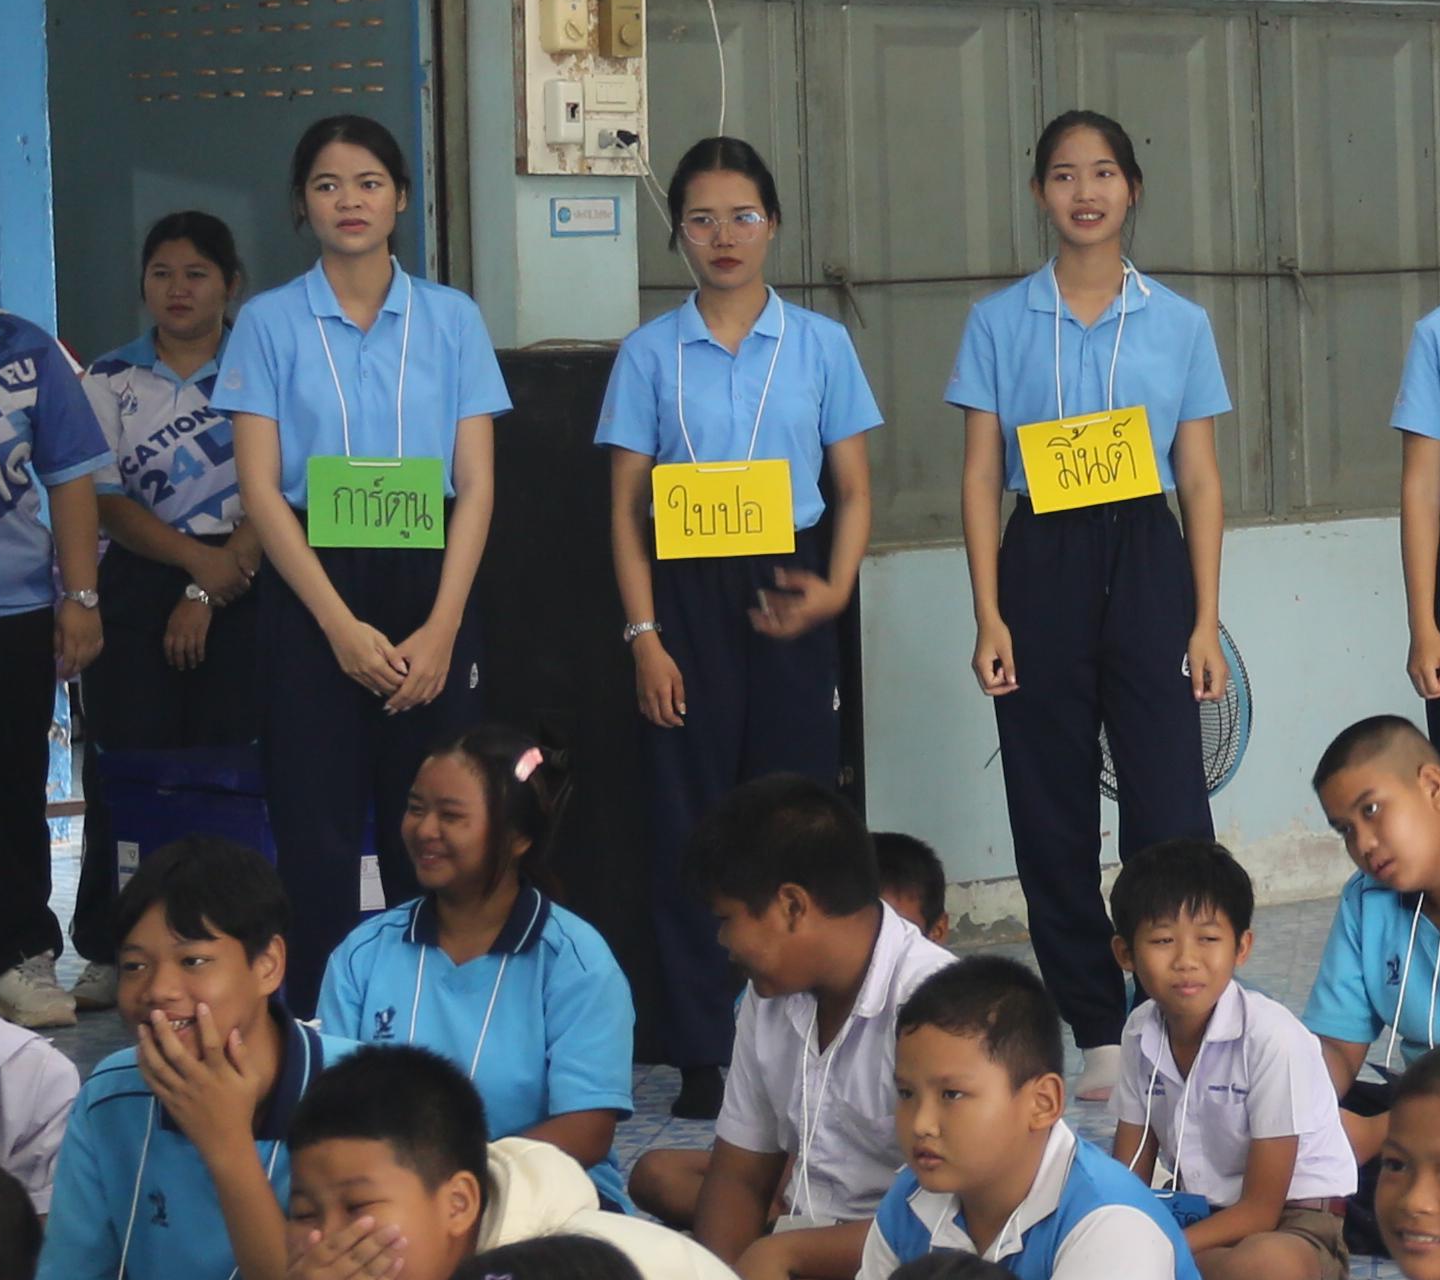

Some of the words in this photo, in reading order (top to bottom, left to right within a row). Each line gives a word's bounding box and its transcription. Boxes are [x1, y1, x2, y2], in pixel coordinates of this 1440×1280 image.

[332, 476, 434, 539] การ์ตูน
[667, 483, 764, 539] ใบปอ
